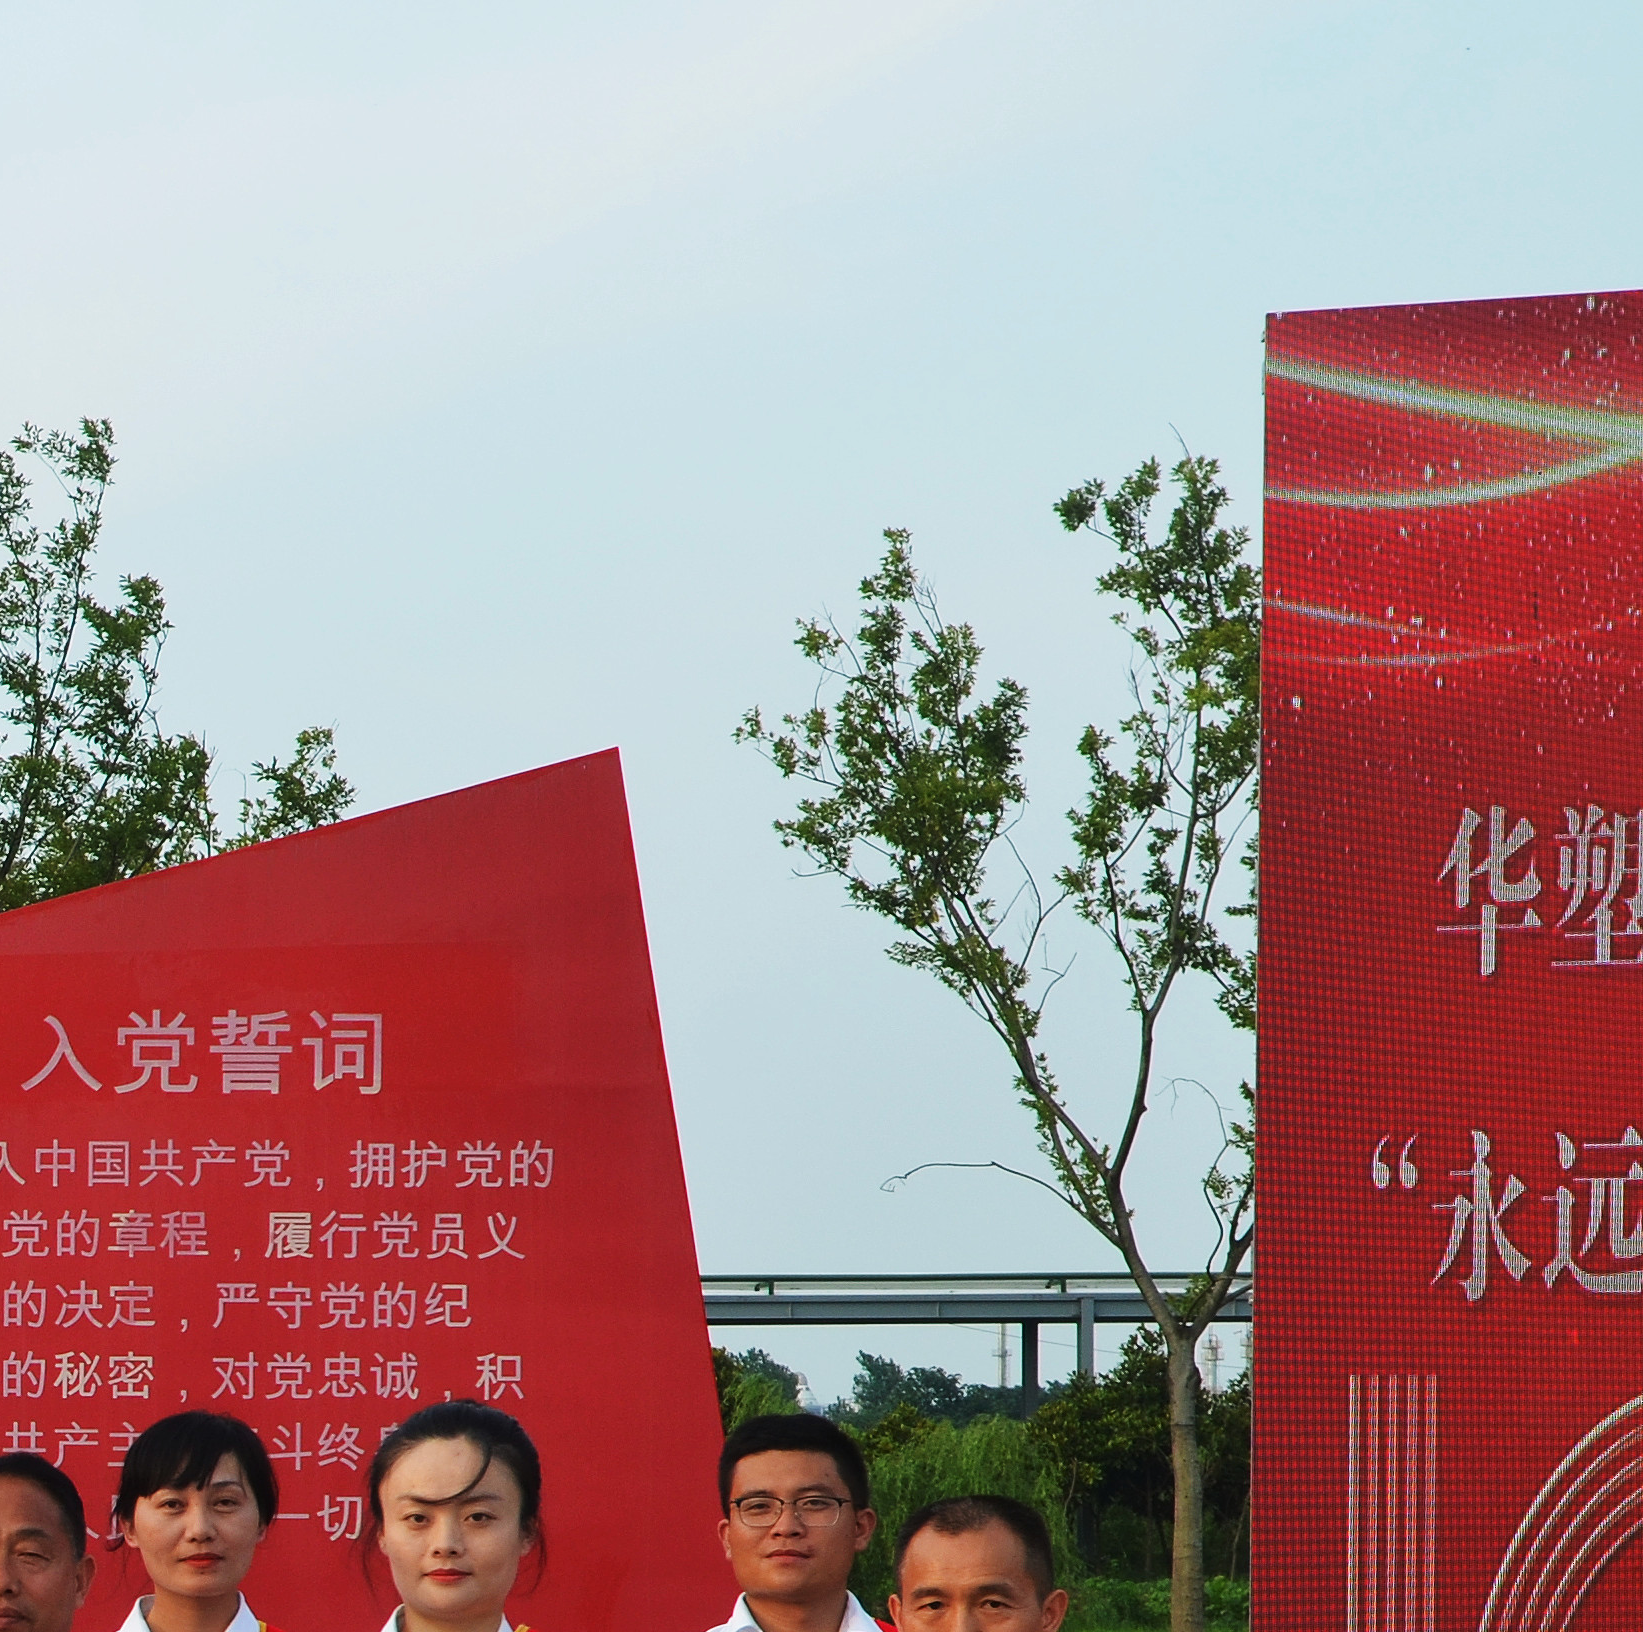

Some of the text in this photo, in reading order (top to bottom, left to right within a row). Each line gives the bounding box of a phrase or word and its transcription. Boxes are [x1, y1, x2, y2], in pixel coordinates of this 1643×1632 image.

[1436, 803, 1643, 977] 华塑
[20, 1009, 383, 1096] 入党誓词
